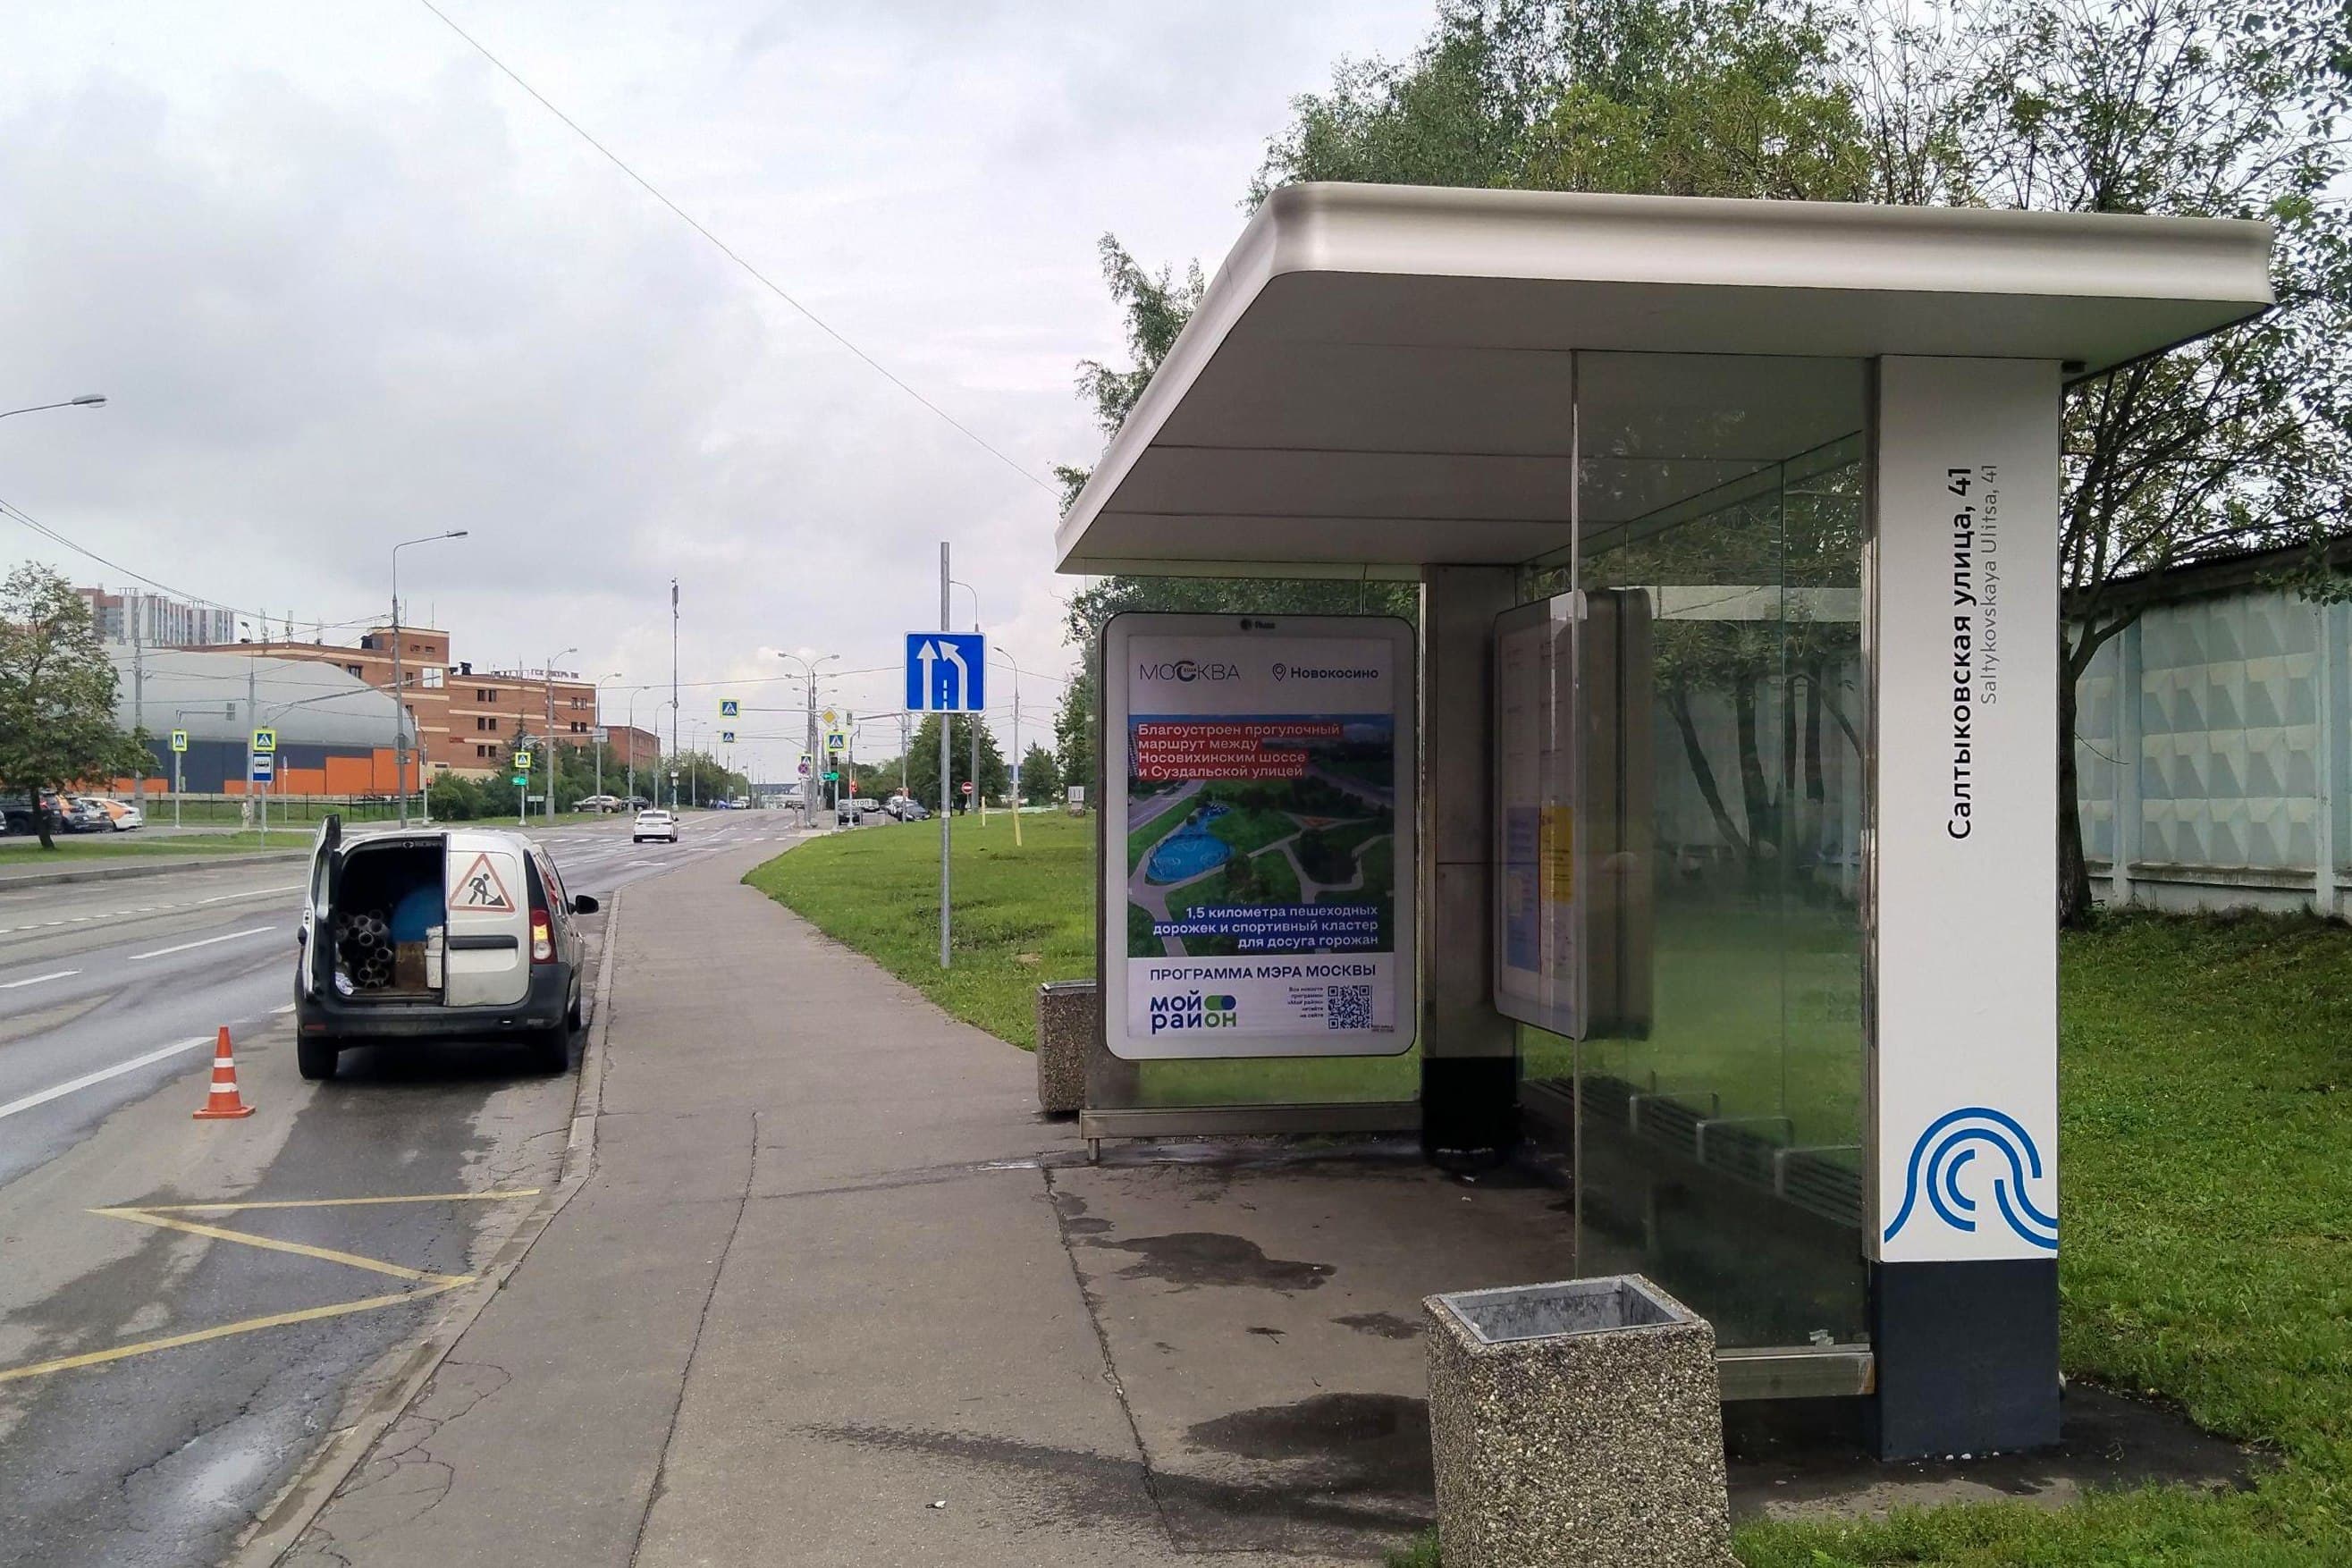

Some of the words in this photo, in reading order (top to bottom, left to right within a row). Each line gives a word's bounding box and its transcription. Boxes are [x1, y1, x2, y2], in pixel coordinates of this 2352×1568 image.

[1948, 468, 1971, 497] 41
[1981, 465, 1997, 484] 41
[1981, 490, 2000, 553] Ulitsa,
[1954, 506, 1977, 606] улица,
[1980, 561, 2000, 704] Saltykovskaya
[1140, 661, 1240, 682] МОСКВА
[1291, 667, 1378, 679] Новокосино
[1138, 724, 1241, 738] Благоустроен
[1245, 723, 1340, 738] прогулочный
[1948, 616, 1971, 839] Салтыковская
[1138, 740, 1205, 751] маршрут
[1210, 740, 1258, 751] между
[1139, 752, 1255, 763] Носовихинским
[1259, 754, 1305, 763] шоссе
[1139, 769, 1147, 777] и
[1151, 764, 1248, 780] Суздальской
[1252, 764, 1302, 779] улицей
[1186, 906, 1205, 919] 1,5
[1209, 907, 1286, 920] километра
[1290, 906, 1378, 917] пешеходных
[1153, 923, 1217, 937] дорожек
[1220, 924, 1228, 932] и
[1232, 920, 1319, 934] спортивный
[1322, 921, 1378, 932] кластер
[1238, 938, 1264, 948] для
[1268, 937, 1316, 948] досуга
[1319, 936, 1378, 948] горожан
[1150, 968, 1253, 981] ПРОГРАММА
[1257, 966, 1302, 978] МЭРА
[1306, 965, 1376, 977] МОСКВЫ
[1150, 990, 1201, 1012] мой
